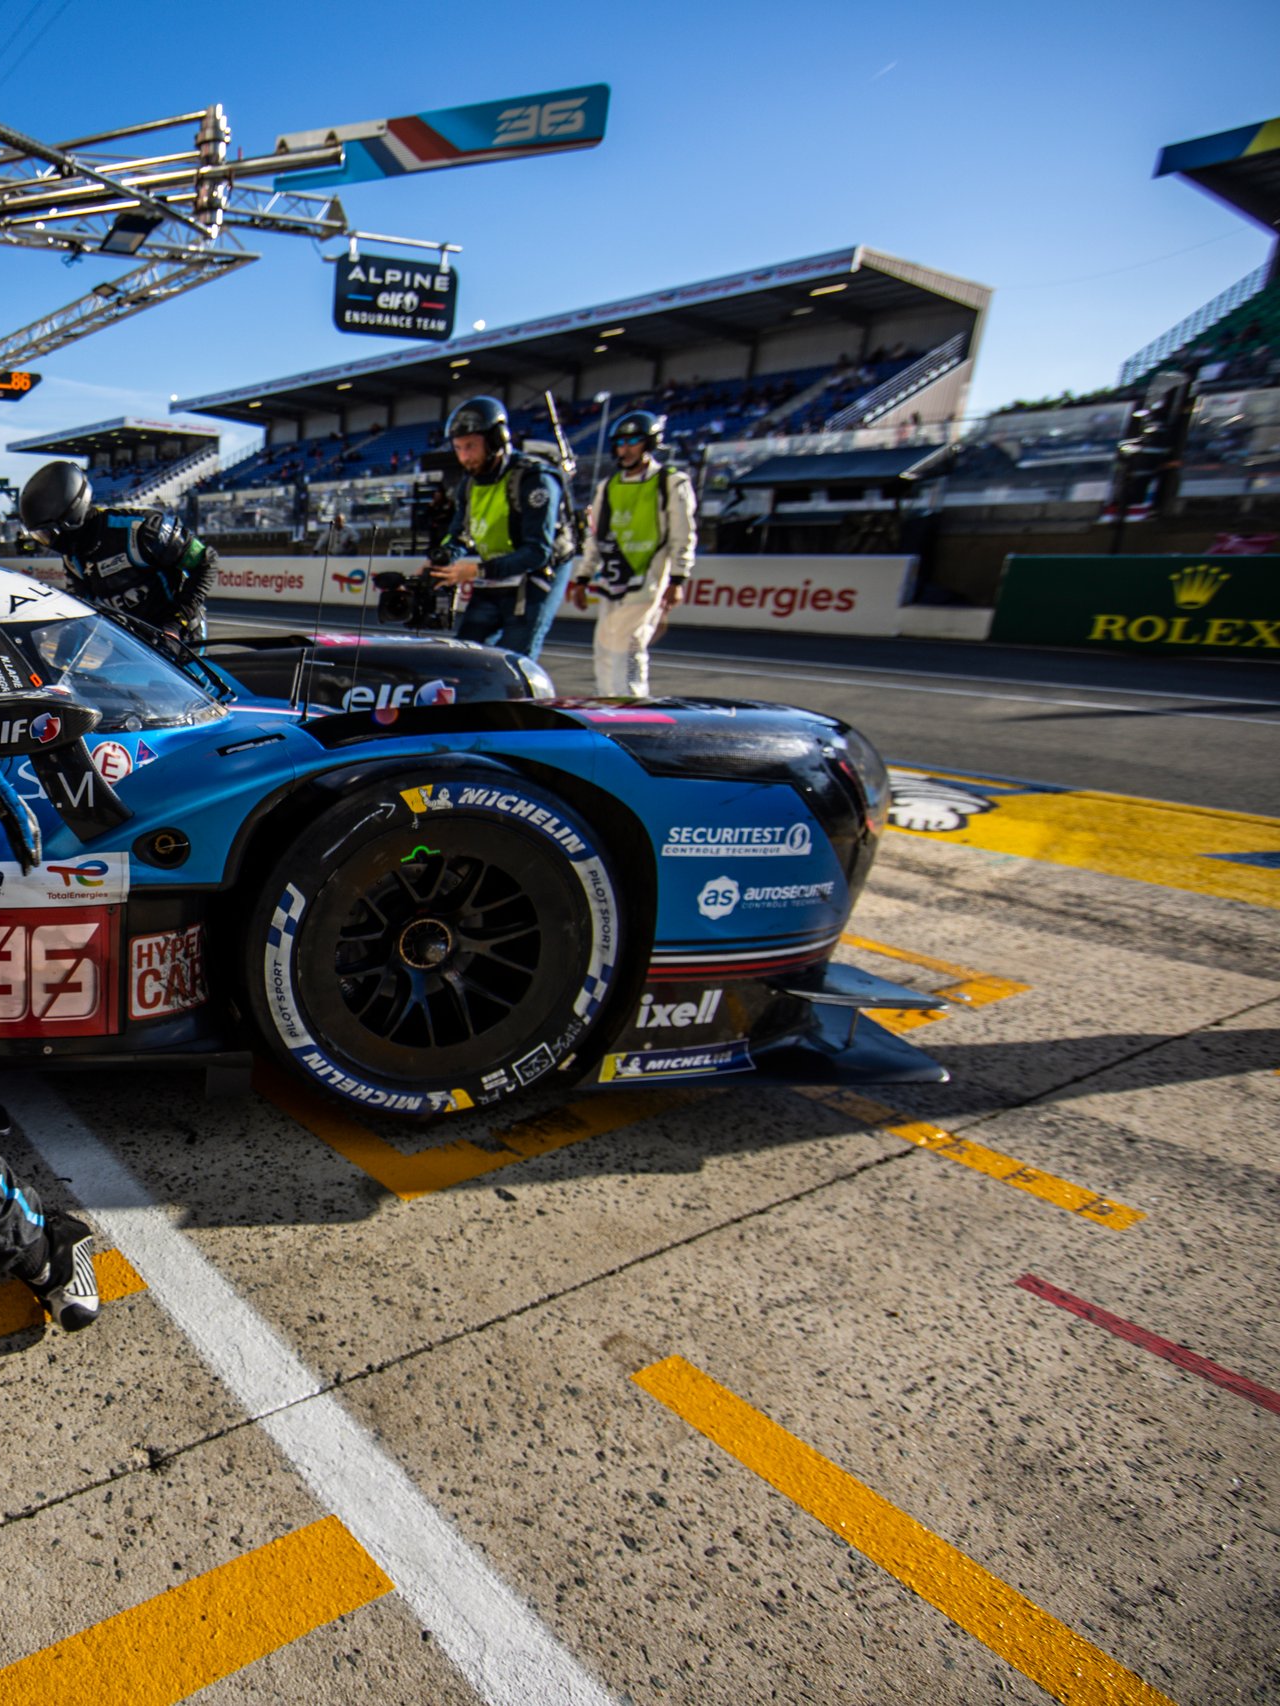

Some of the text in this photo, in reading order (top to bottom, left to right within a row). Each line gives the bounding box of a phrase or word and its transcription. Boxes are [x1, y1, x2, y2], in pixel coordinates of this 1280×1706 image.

[492, 96, 588, 145] 36
[347, 265, 450, 292] ALPINE
[376, 291, 404, 310] elf
[344, 309, 447, 331] ENDURANCE TEAM
[11, 371, 31, 391] 86
[217, 569, 858, 617] TotalEnergies lEnergies
[1086, 613, 1280, 648] ROLEX
[342, 684, 414, 713] elf
[458, 787, 587, 855] MICHELIN
[668, 826, 785, 844] SECURITEST
[47, 891, 109, 900] TotalEnergies
[588, 868, 611, 951] PILOT SPORT
[703, 888, 734, 907] as
[274, 959, 300, 1038] PILOT SPORT
[636, 989, 723, 1028] ixell
[645, 1051, 733, 1071] MICHELIN
[303, 1051, 422, 1111] MICHELIN
